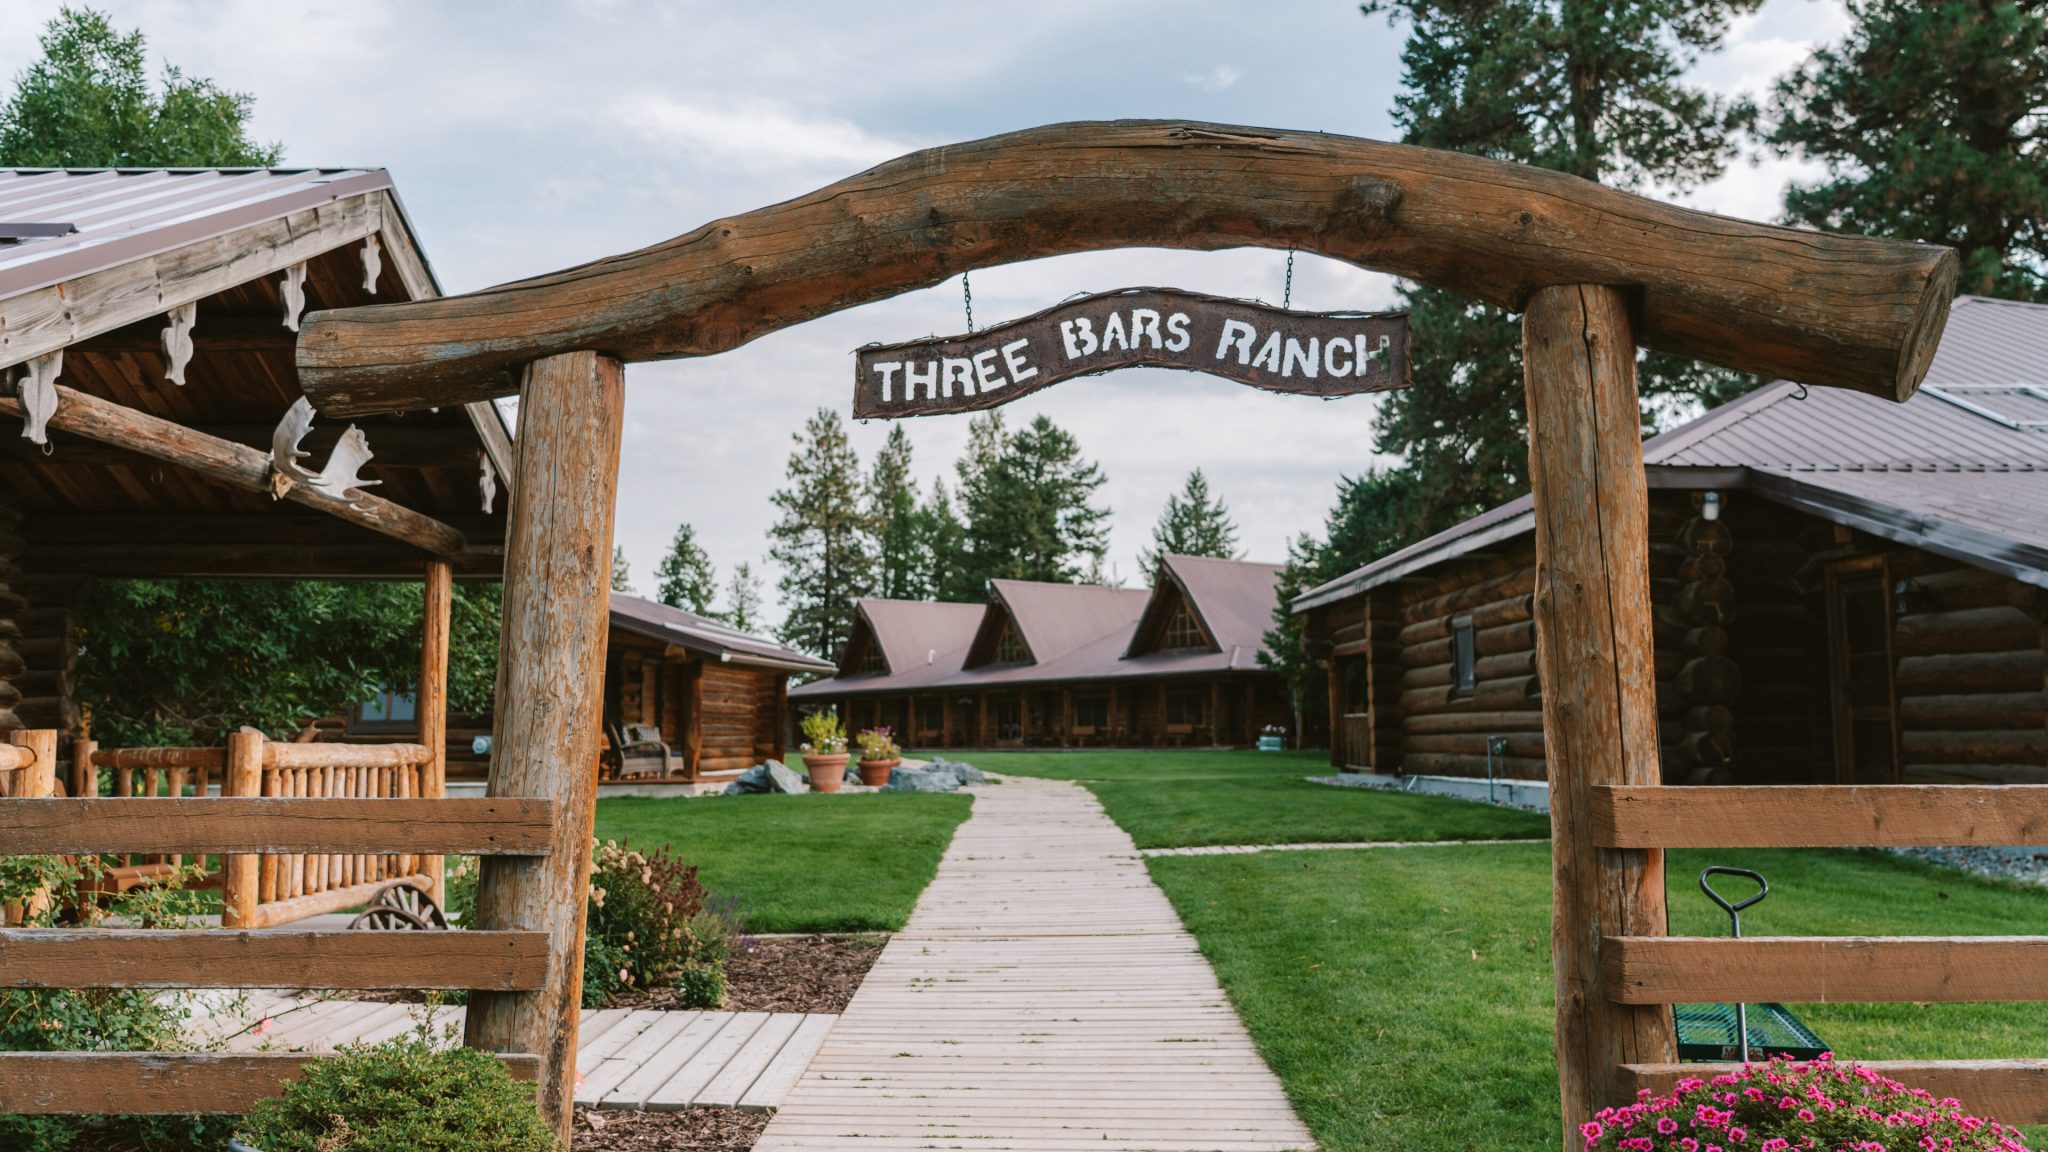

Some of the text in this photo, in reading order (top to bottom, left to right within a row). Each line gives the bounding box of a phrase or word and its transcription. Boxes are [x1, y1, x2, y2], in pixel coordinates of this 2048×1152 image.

[873, 308, 1389, 402] THREE BARS RANCH
